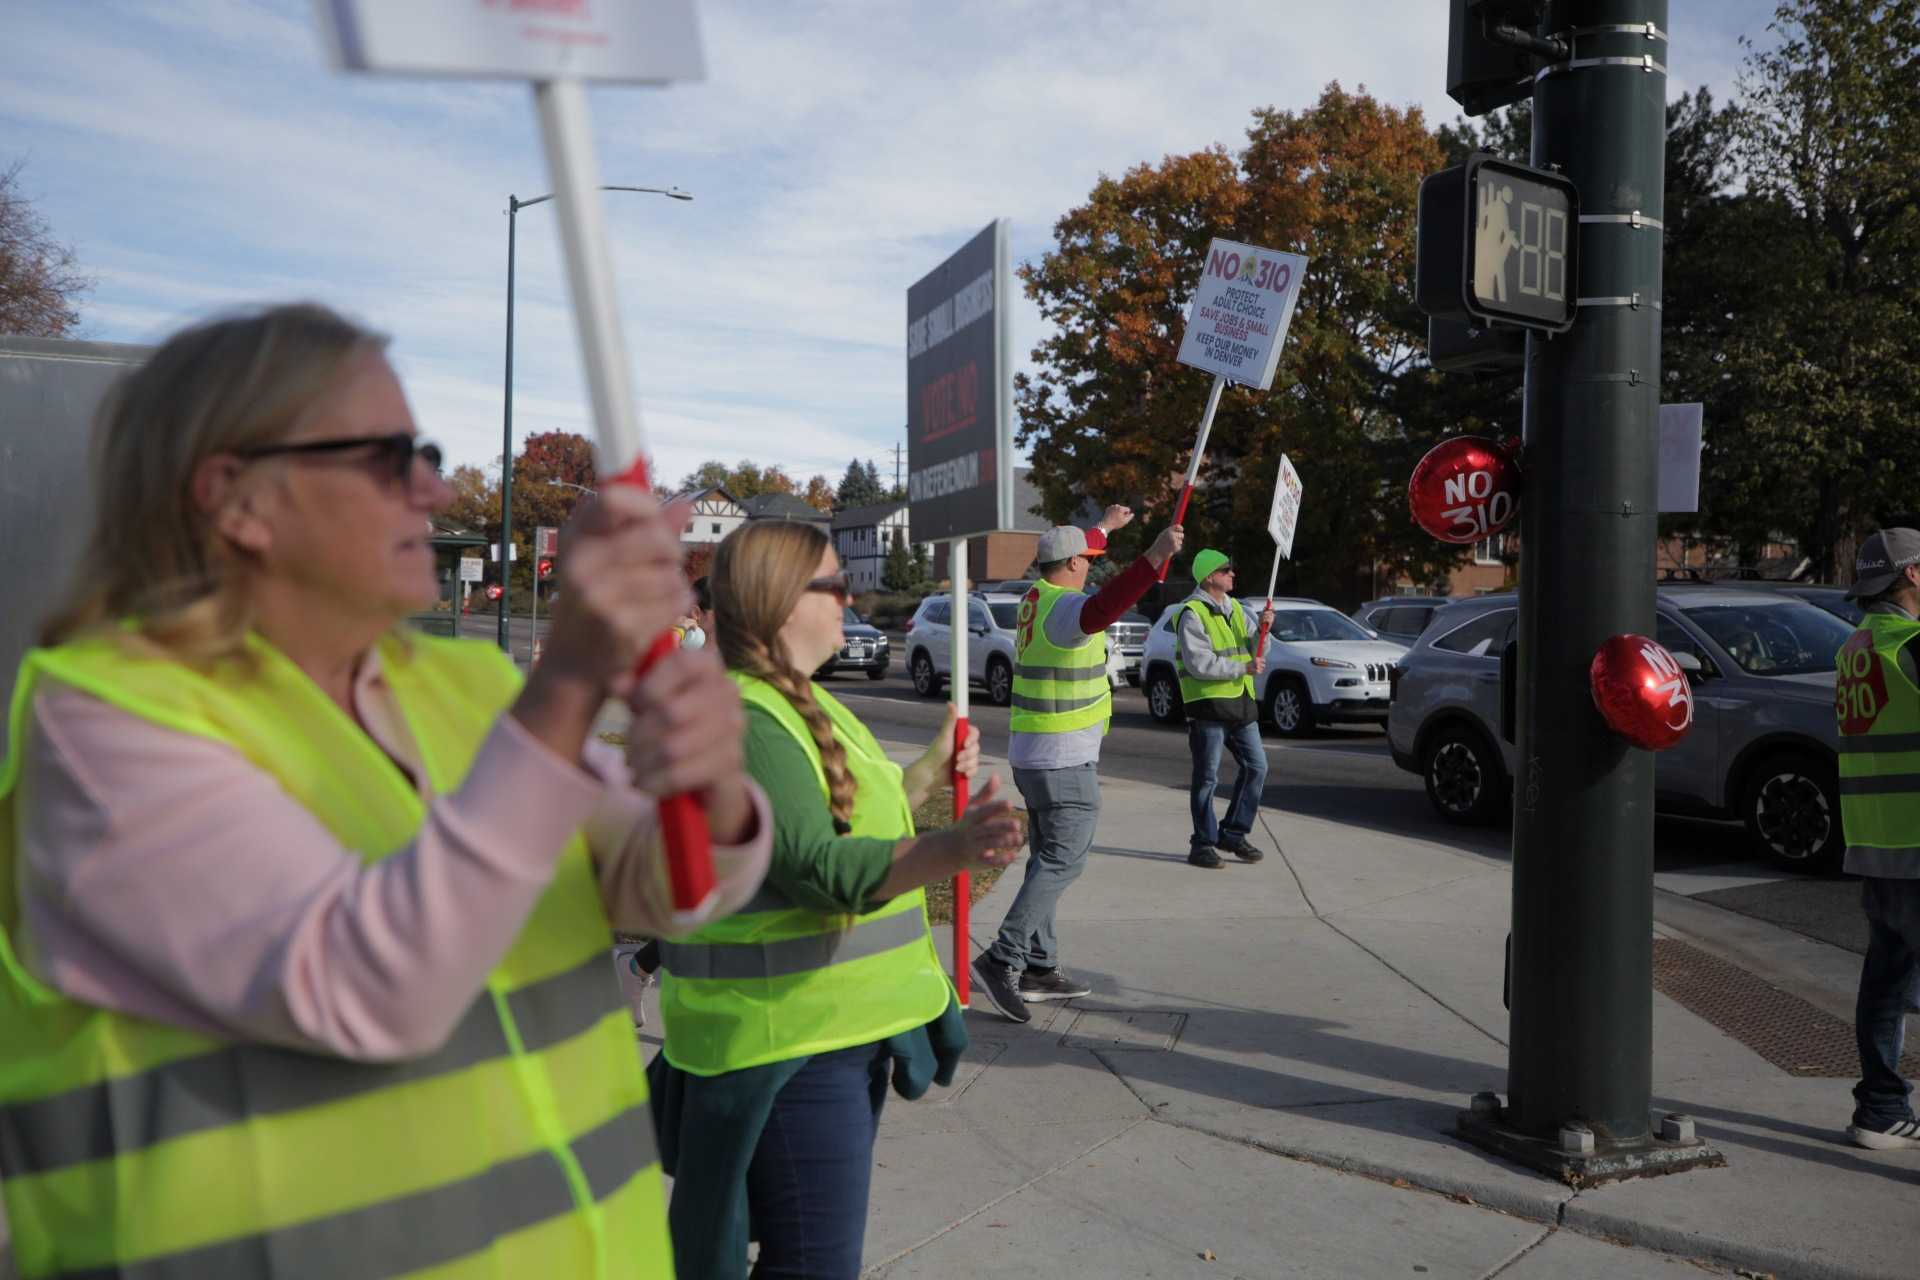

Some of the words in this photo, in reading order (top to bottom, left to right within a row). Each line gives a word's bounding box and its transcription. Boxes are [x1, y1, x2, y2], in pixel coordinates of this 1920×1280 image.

[1207, 249, 1241, 281] NO
[1255, 260, 1290, 293] 310
[1213, 296, 1237, 310] ADULT
[1236, 302, 1266, 319] CHOICE
[1226, 286, 1260, 304] PROTECT
[1200, 306, 1220, 321] SAVE
[1219, 313, 1239, 327] JOBS
[1245, 319, 1269, 336] SMALL
[1214, 322, 1249, 342] BUSINESS
[1195, 331, 1215, 346] KEEP
[1214, 337, 1232, 352] OUR
[1230, 342, 1259, 361] MONEY
[1204, 346, 1214, 358] IN
[1213, 349, 1243, 368] DENVER
[1444, 471, 1493, 505] NO
[1440, 490, 1512, 540] 310
[1835, 648, 1872, 678] NO
[1837, 682, 1876, 719] 310
